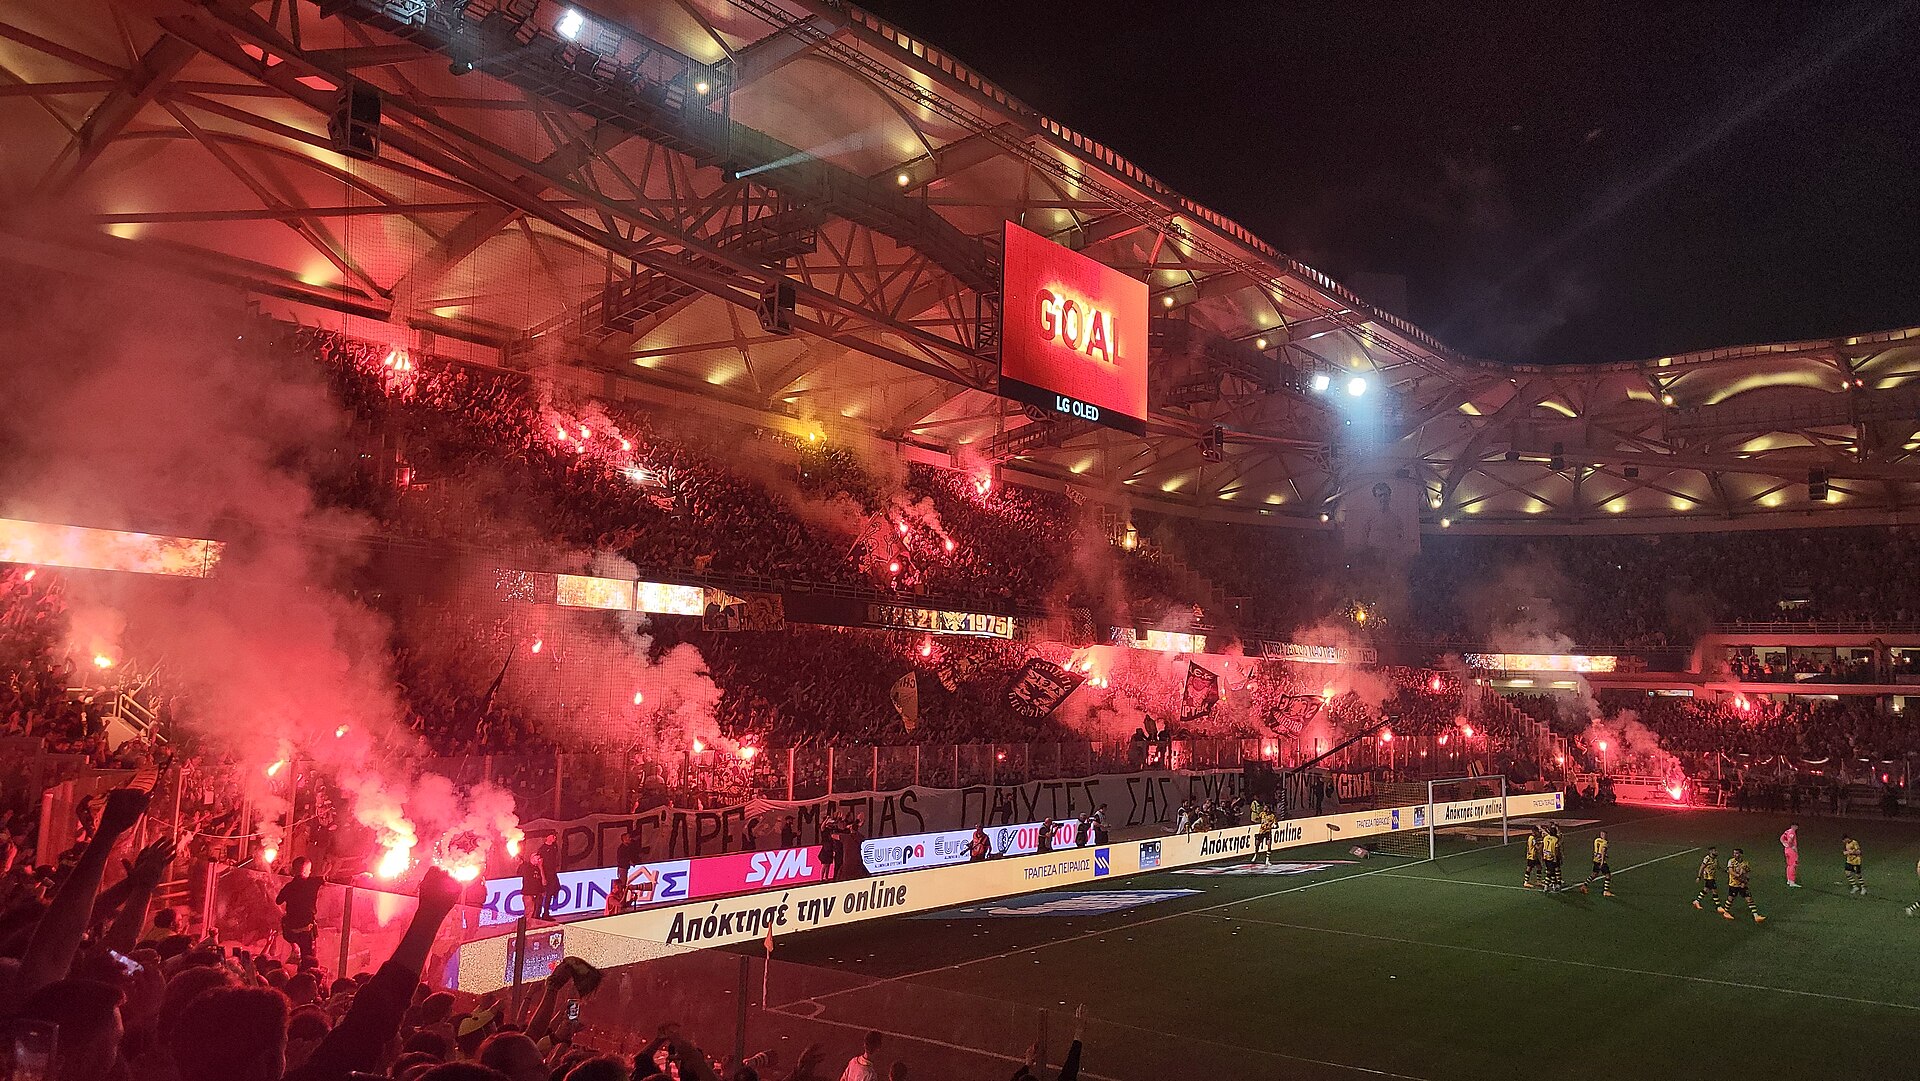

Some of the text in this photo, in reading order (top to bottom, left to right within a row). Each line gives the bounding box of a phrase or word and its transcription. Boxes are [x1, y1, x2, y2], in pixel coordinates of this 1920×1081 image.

[1035, 288, 1125, 366] GOAL
[1056, 395, 1099, 421] LG OLED
[917, 609, 939, 629] 21
[967, 613, 1008, 635] 1975
[1125, 776, 1171, 827] ΣΑΣ
[1444, 802, 1474, 821] Απόκτησέ
[864, 843, 925, 866] Europa
[1199, 827, 1251, 857] Απόκτησέ
[1274, 822, 1302, 844] online
[745, 847, 813, 886] SYM
[1024, 858, 1091, 880] ΤΡΑΠΕΖΑ ΠΕΙΡΑΙΩΣ
[666, 880, 907, 945] Απόκτησέ την online
